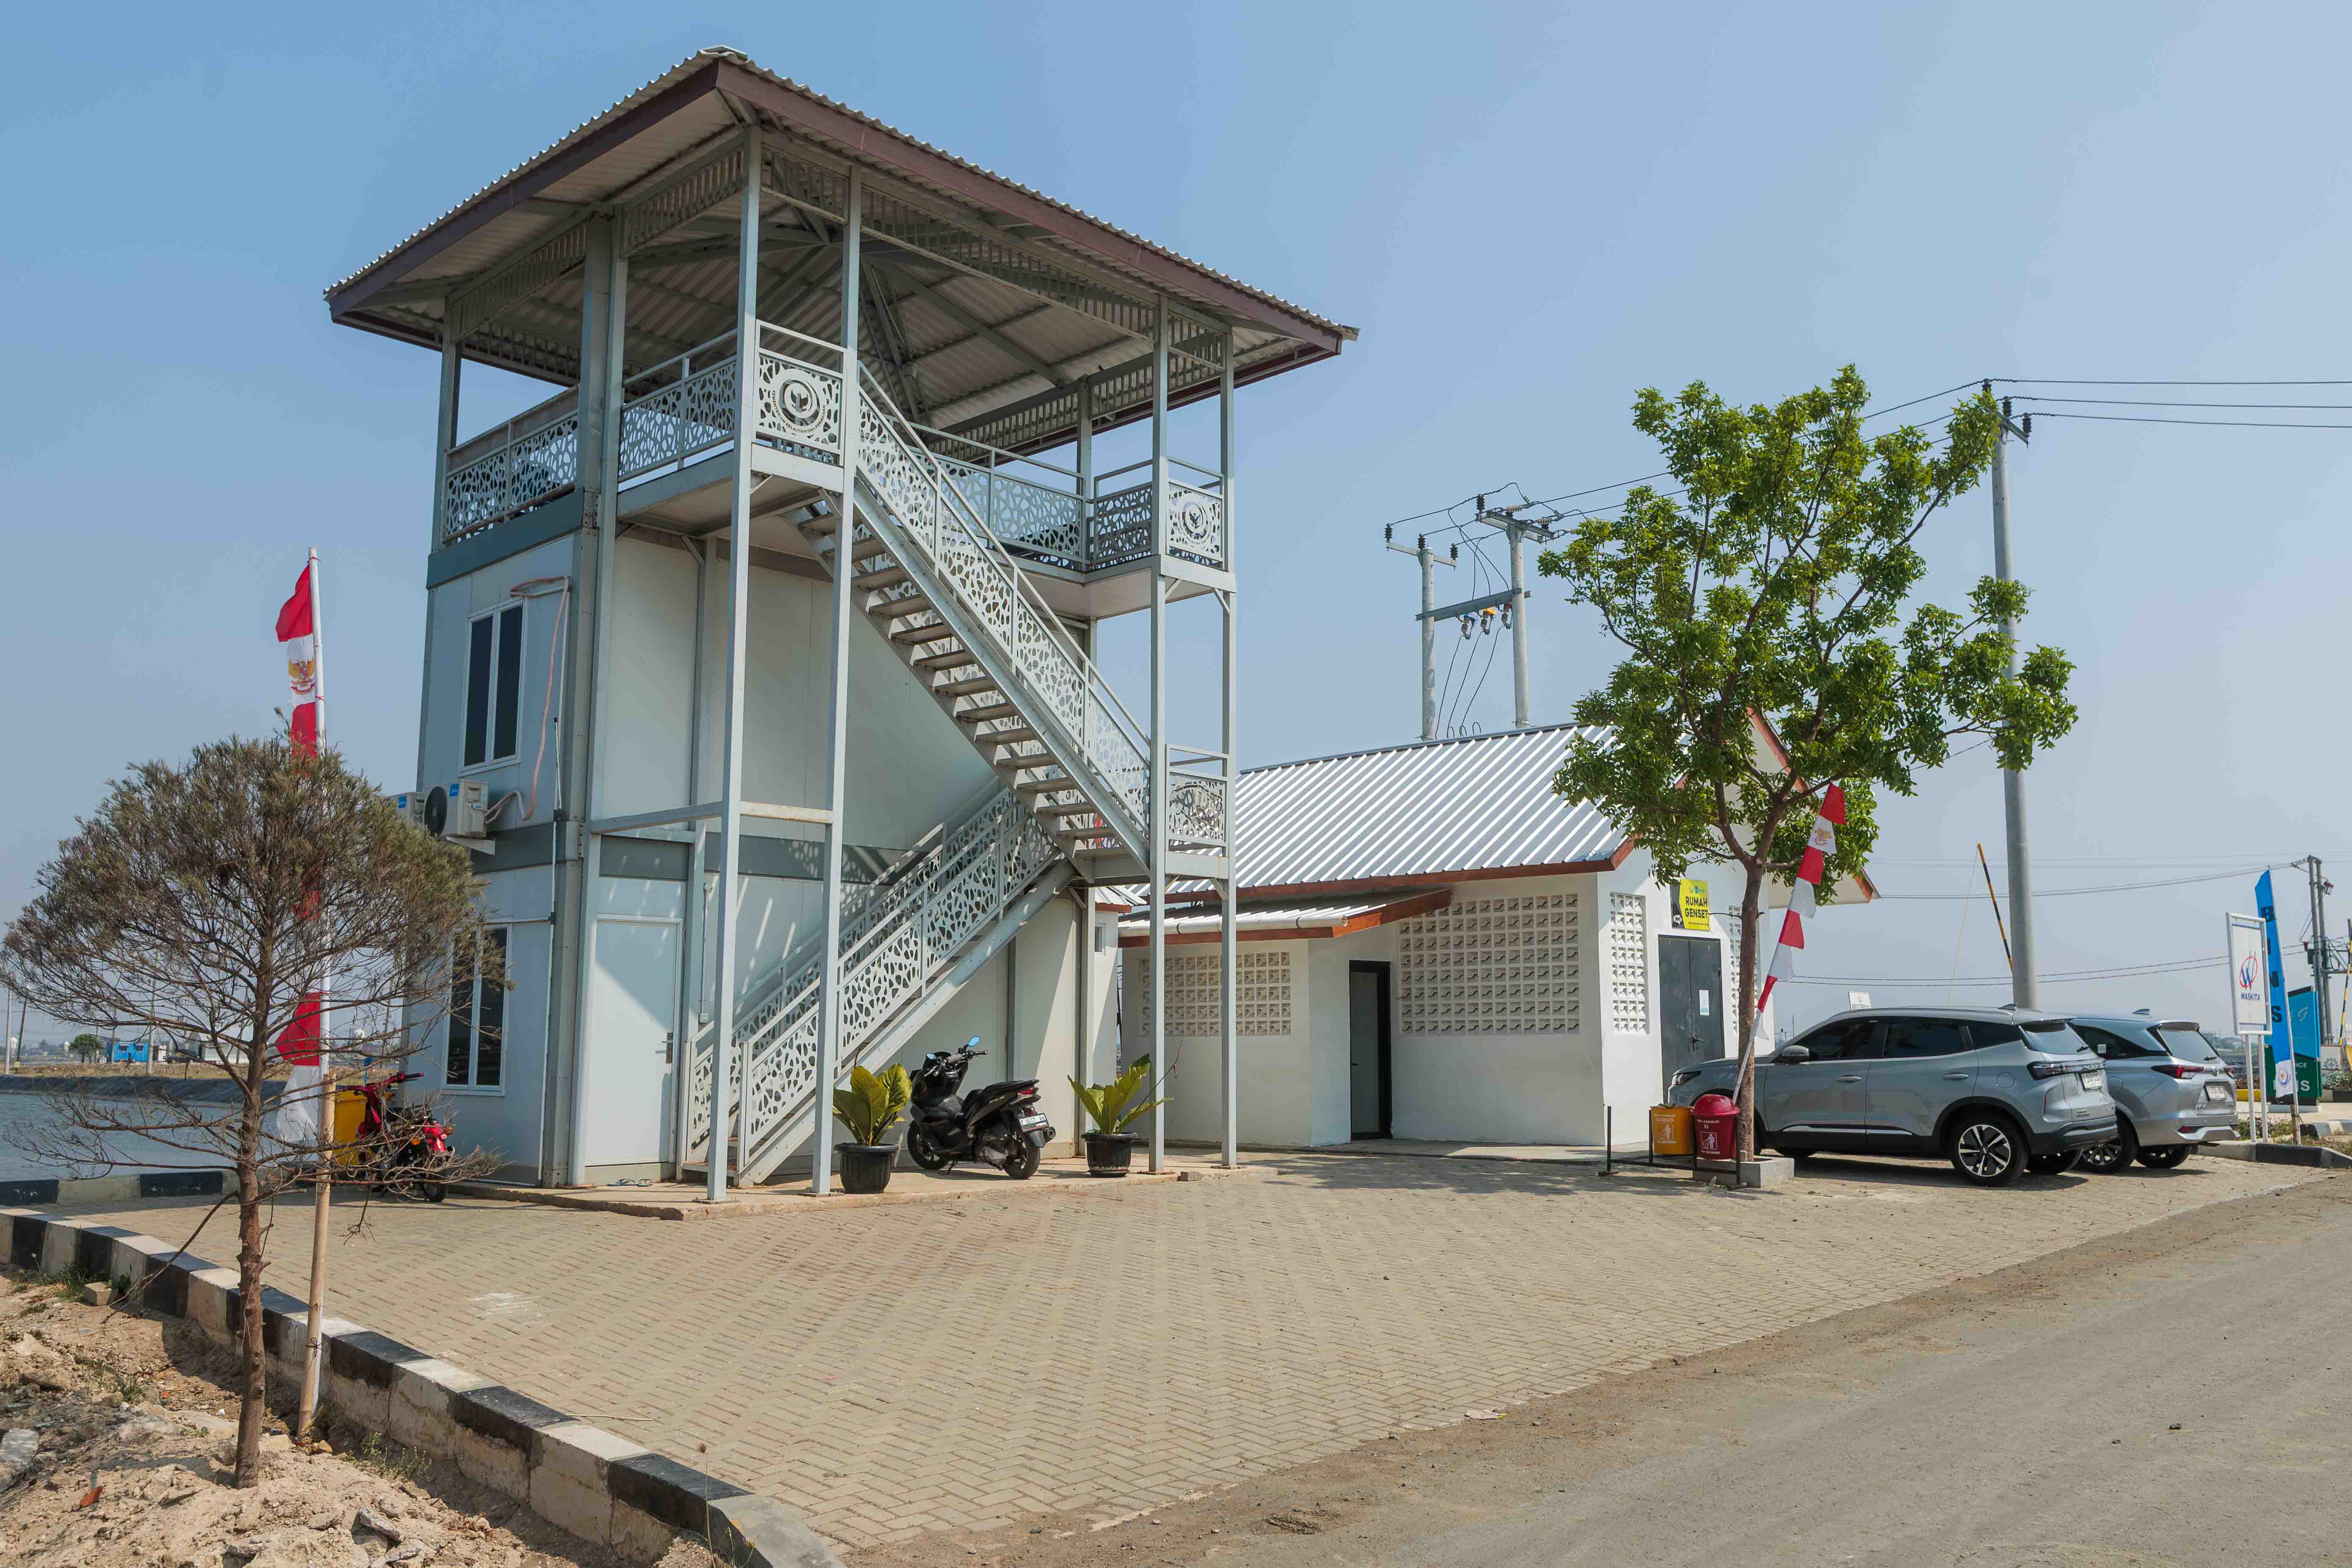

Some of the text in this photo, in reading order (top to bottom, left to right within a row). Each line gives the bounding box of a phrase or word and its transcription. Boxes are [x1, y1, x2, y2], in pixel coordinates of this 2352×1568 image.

[786, 423, 807, 433] KELAUTAN
[1685, 896, 1707, 907] RUMAH
[1685, 908, 1708, 919] GENSET
[2240, 992, 2261, 1001] WASKITA
